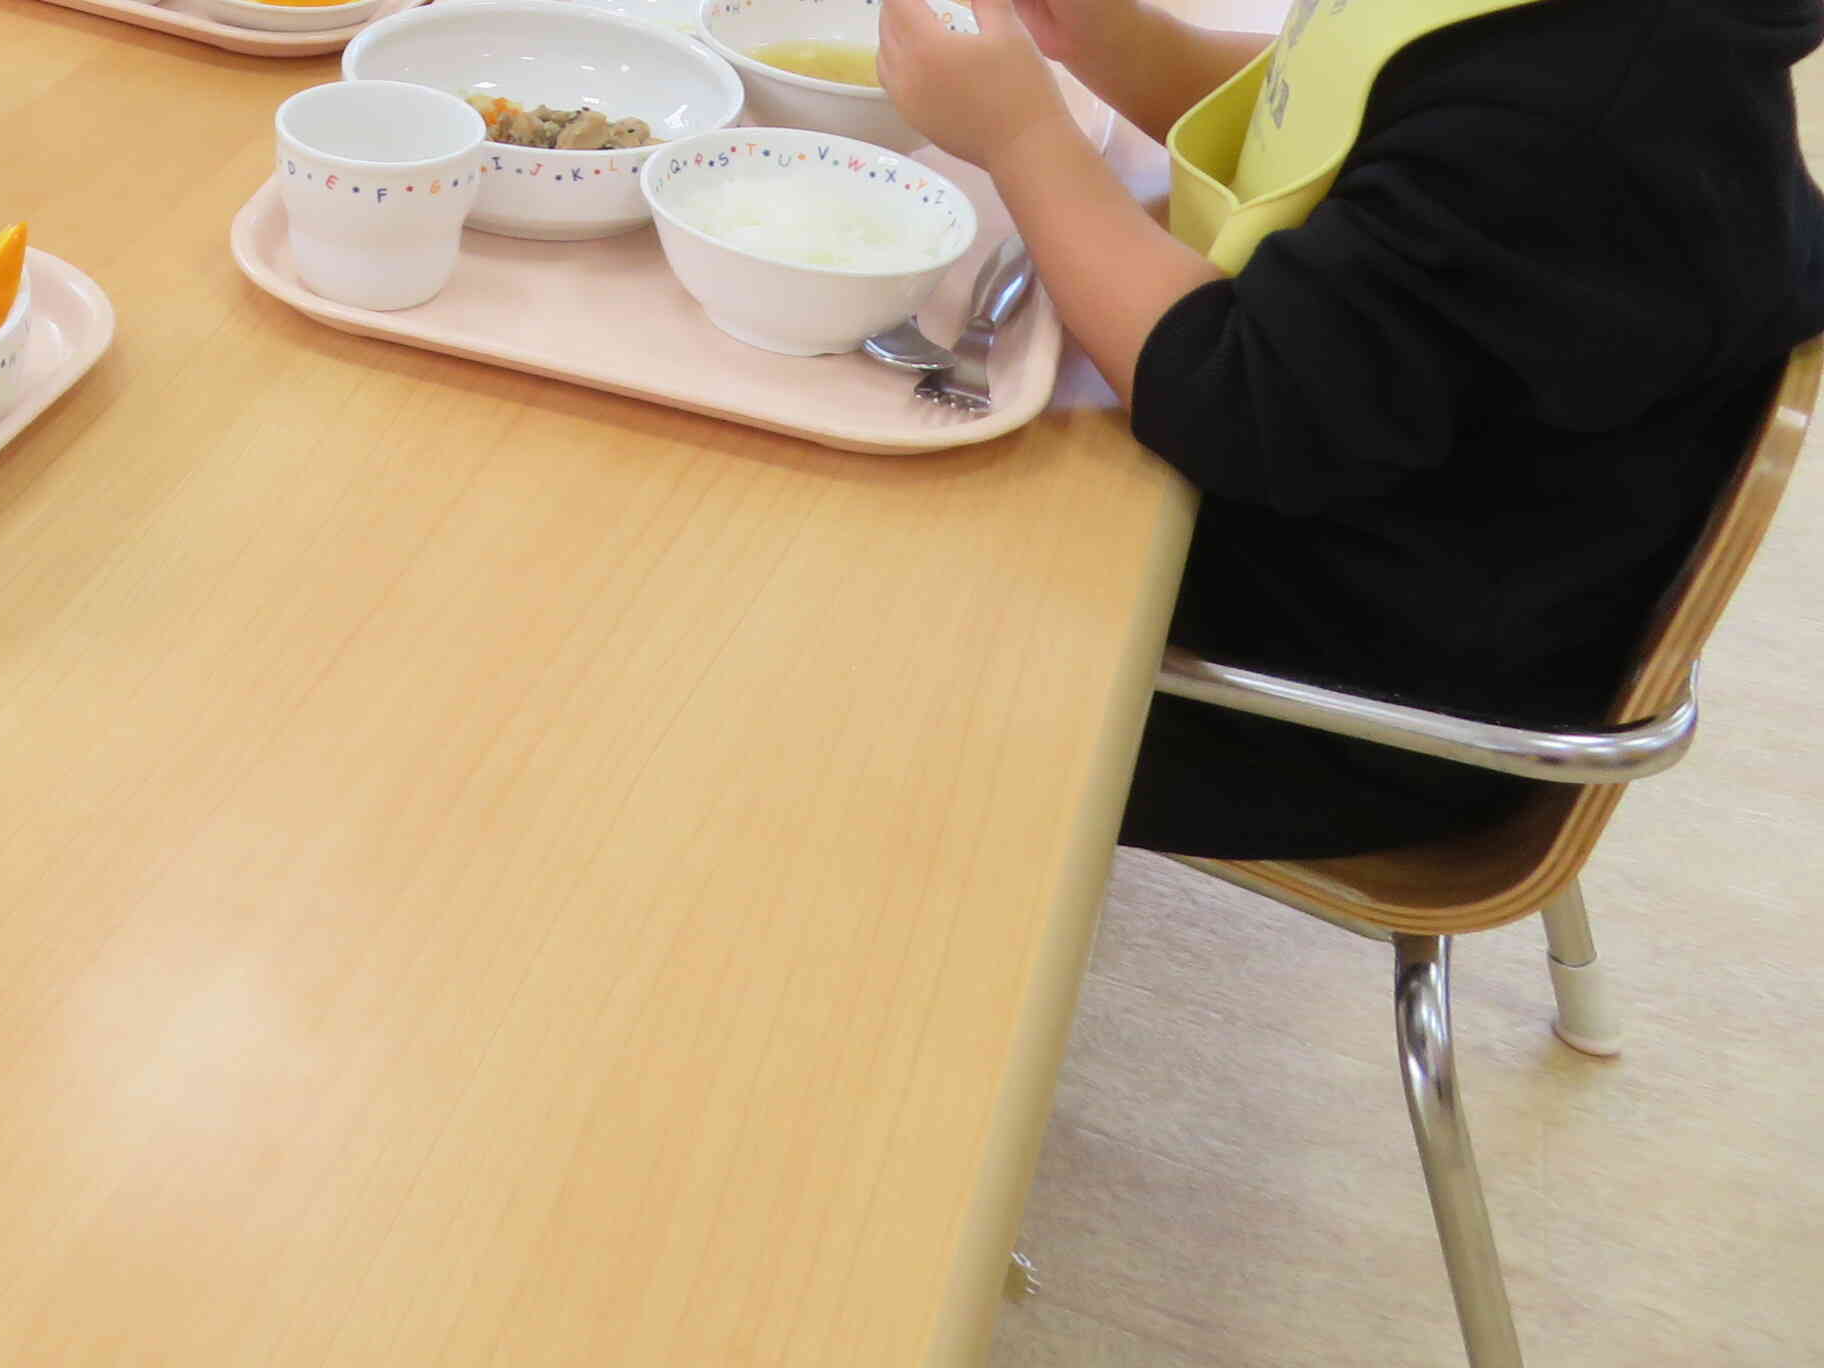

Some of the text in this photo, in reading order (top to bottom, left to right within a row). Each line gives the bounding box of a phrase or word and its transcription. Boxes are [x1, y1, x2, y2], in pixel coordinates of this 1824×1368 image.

[492, 155, 503, 170] I
[529, 162, 544, 176] J
[571, 167, 584, 182] K
[670, 158, 681, 174] Q
[817, 145, 830, 160] V
[885, 168, 897, 183] X
[326, 175, 339, 190] E
[377, 188, 388, 203] F
